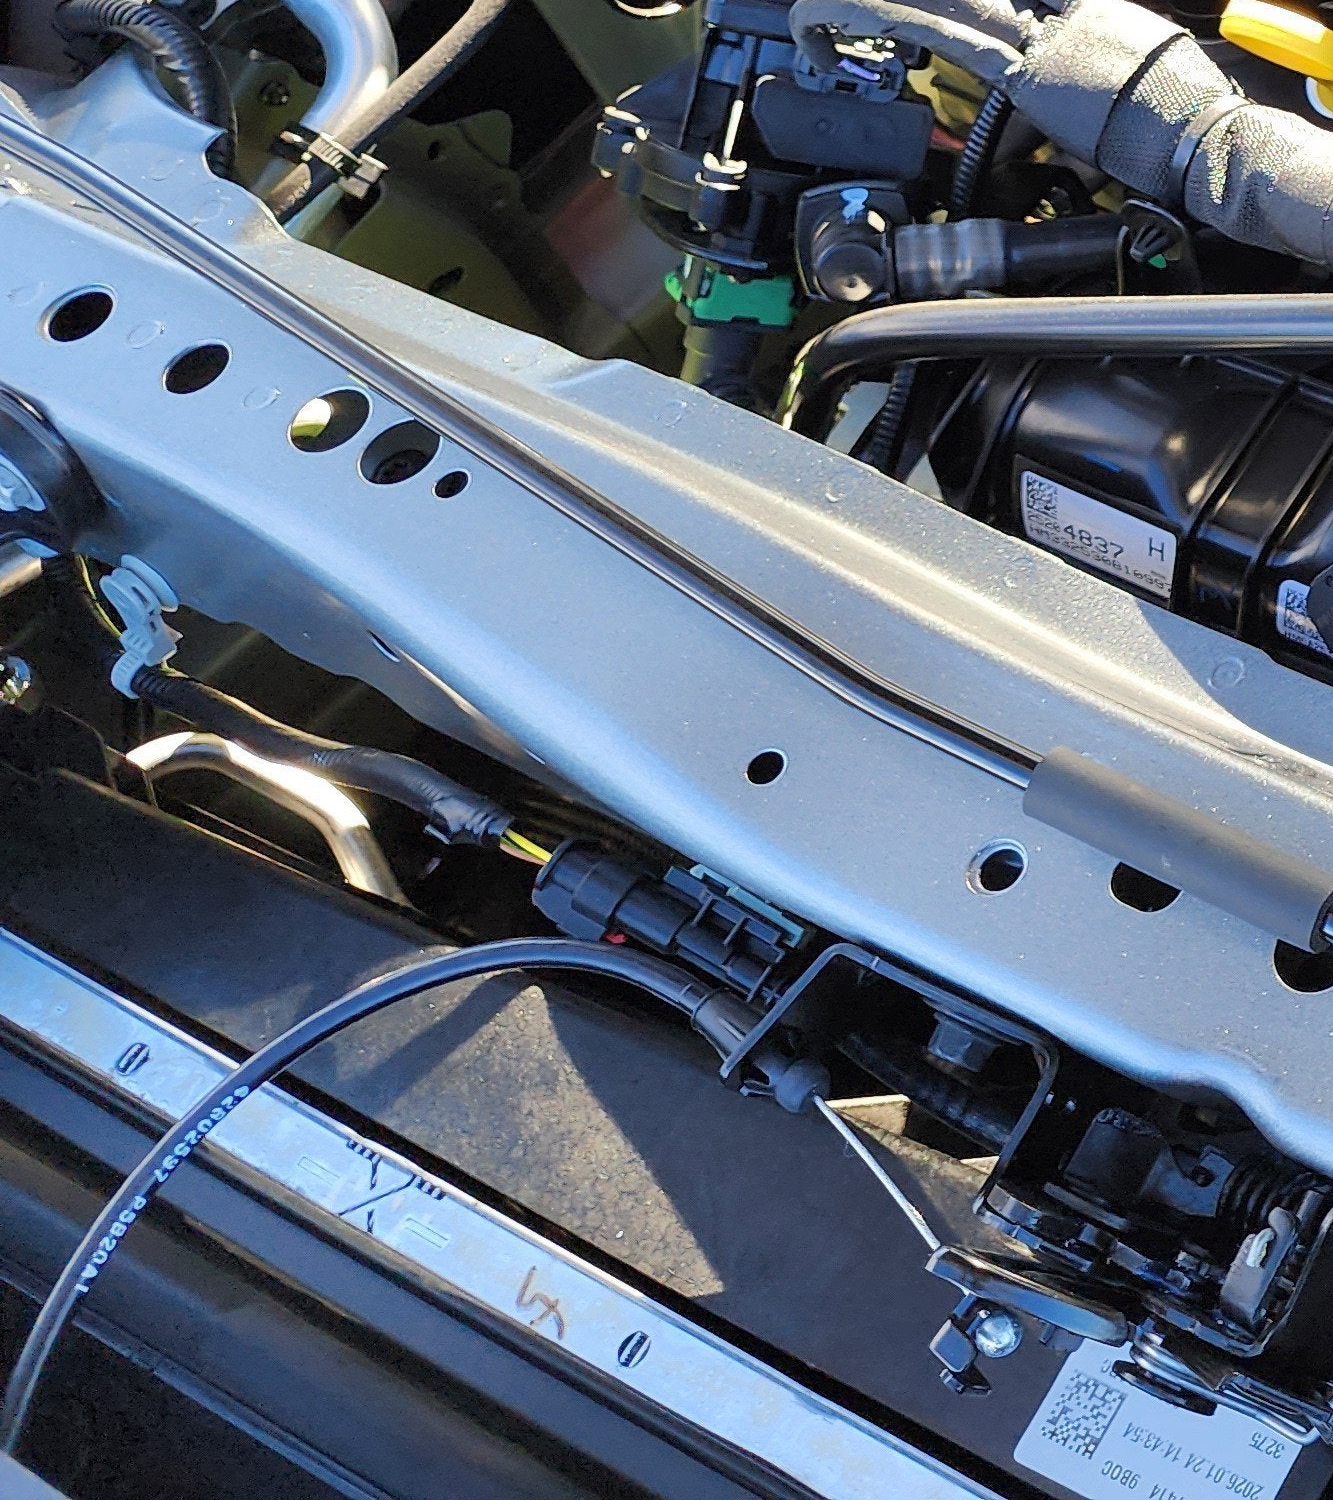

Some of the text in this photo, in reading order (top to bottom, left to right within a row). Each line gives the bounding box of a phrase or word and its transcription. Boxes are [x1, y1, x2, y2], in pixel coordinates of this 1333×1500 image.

[1148, 536, 1166, 562] H
[1248, 1430, 1285, 1460] 3275
[1121, 1421, 1263, 1500] 2026.01.24 14:43:54
